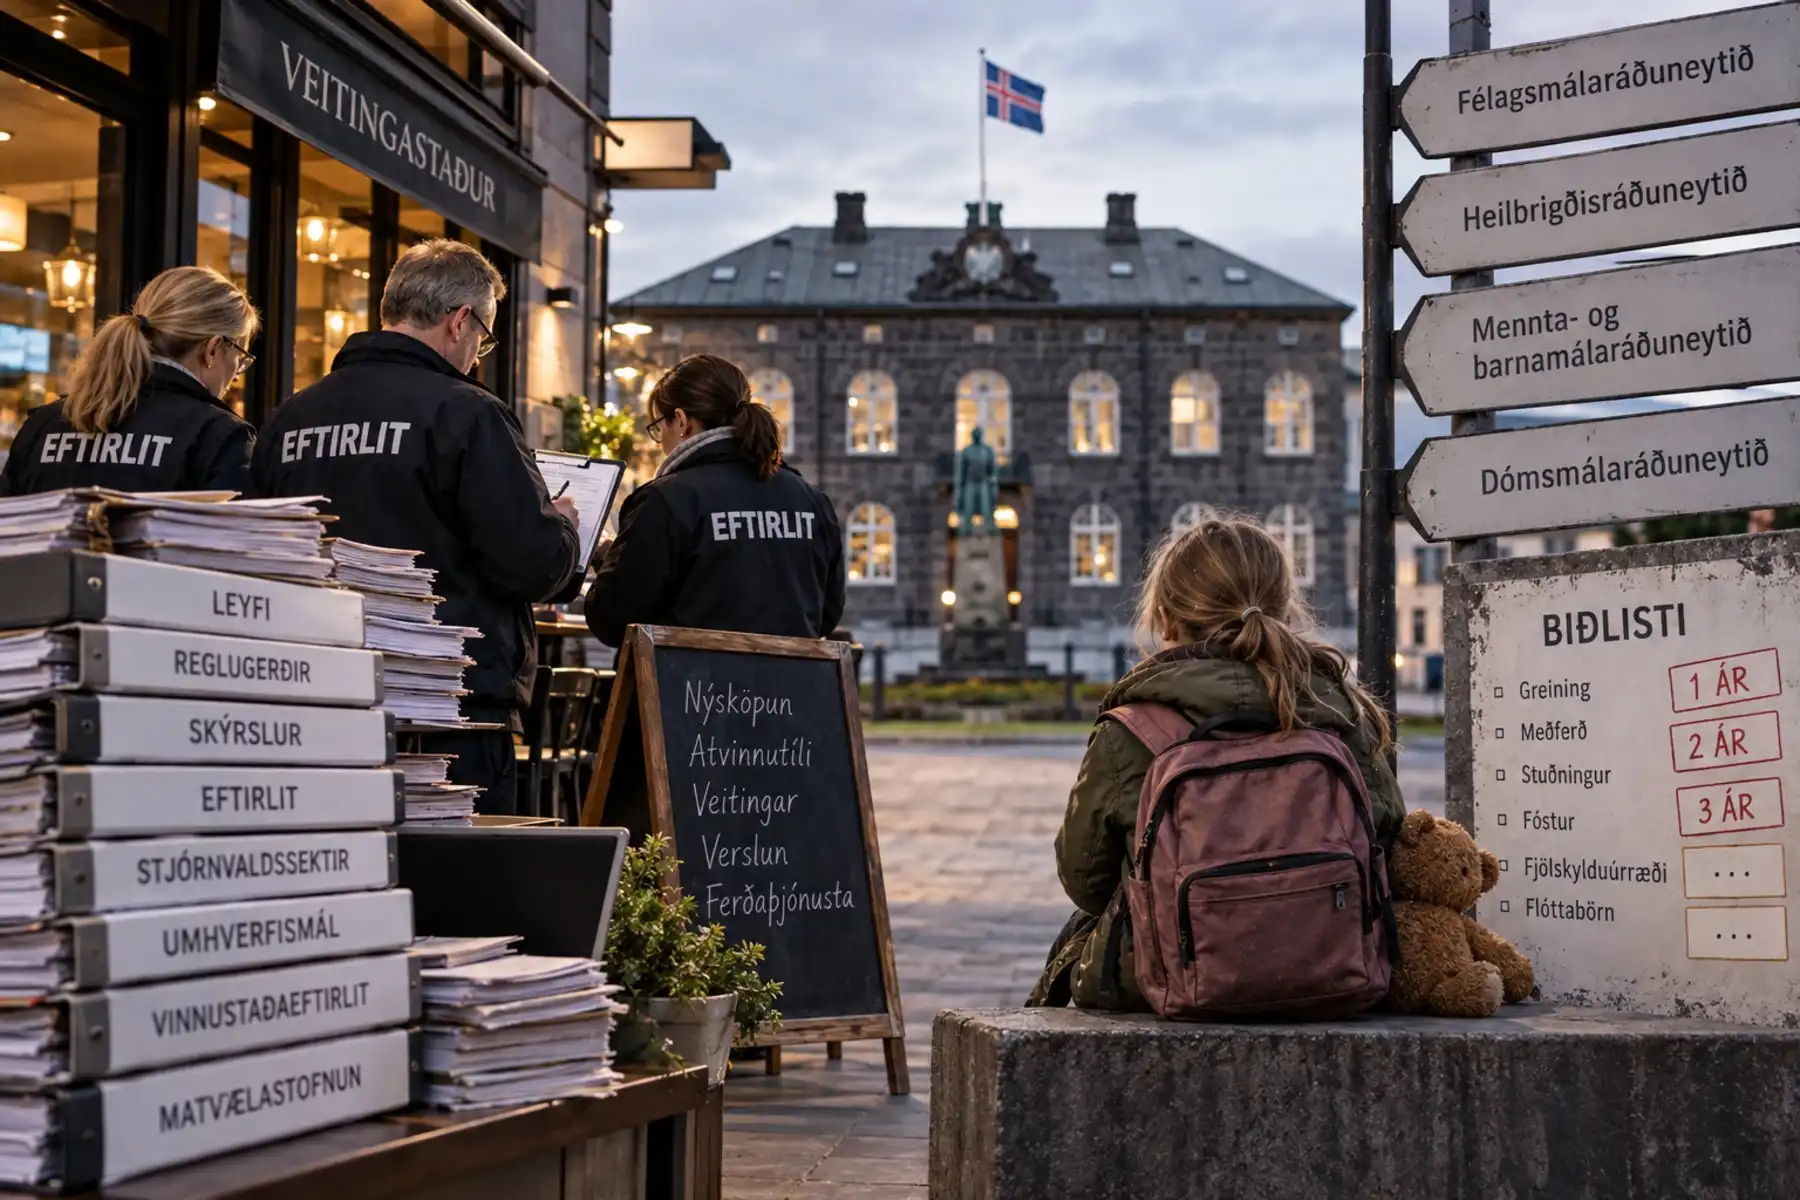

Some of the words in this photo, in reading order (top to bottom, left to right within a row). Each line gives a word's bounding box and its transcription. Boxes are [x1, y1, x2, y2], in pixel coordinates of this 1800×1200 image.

[1458, 44, 1755, 115] Félagsmálaráðuneytið
[280, 40, 497, 213] VEITINGASTAÐUR
[1463, 165, 1748, 232] Heilbrigðisráðuneytið
[1472, 309, 1578, 343] Mennta-
[1588, 304, 1619, 332] og
[1473, 317, 1753, 381] barnamálaráðuneytið
[40, 432, 173, 467] EFTIRLIT
[280, 421, 411, 464] EFTIRLIT
[1481, 438, 1770, 495] Dómsmálaráðuneytið
[711, 511, 815, 541] EFTIRLIT
[212, 590, 271, 621] LEYFI
[1543, 602, 1686, 646] BIÐLISTI
[174, 649, 311, 684] REGLUGERÐIR
[1690, 673, 1699, 700] 1
[1716, 662, 1750, 696] ÁR
[684, 680, 794, 727] Nýsköpun
[1519, 678, 1591, 701] Greining
[189, 714, 303, 747] SKÝRSLUR
[1521, 720, 1588, 741] Meðferð
[1689, 734, 1703, 760] 2
[1714, 723, 1749, 757] ÁR
[689, 733, 813, 768] Atvinnutíli
[1521, 765, 1612, 789] Stuðningur
[201, 785, 299, 813] EFTIRLIT
[693, 783, 799, 827] Veitingar
[1699, 797, 1712, 824] 3
[1722, 788, 1755, 822] ÁR
[1523, 809, 1575, 831] Fóstur
[137, 848, 350, 885] STJÓRNVALDSSEKTIR
[702, 833, 788, 870] Verslun
[1524, 856, 1668, 884] Fjölskylduúrræði
[706, 880, 855, 927] Ferðaþjónusta
[1526, 898, 1615, 922] Flóttabörn
[162, 909, 340, 957] UMHVERFISMÁL
[152, 982, 370, 1037] VINNUSTAÐAEFTIRLIT
[159, 1064, 362, 1134] MATVÆLASTOFNUN
